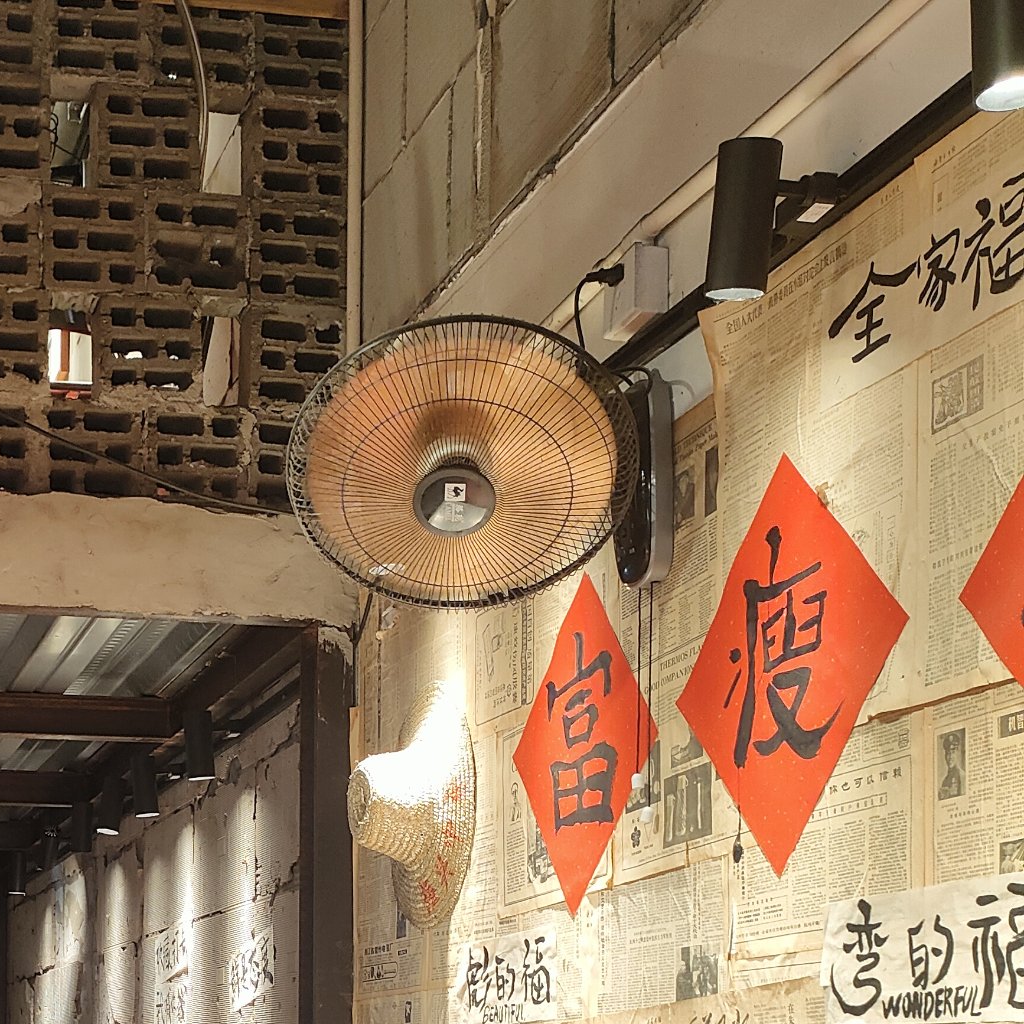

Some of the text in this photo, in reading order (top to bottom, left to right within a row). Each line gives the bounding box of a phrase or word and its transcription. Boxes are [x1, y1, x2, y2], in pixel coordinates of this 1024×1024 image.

[660, 650, 689, 672] THERMOS
[545, 631, 619, 833] 富
[829, 766, 902, 795] 你也可以信赖
[882, 984, 982, 1022] WONDERFUL
